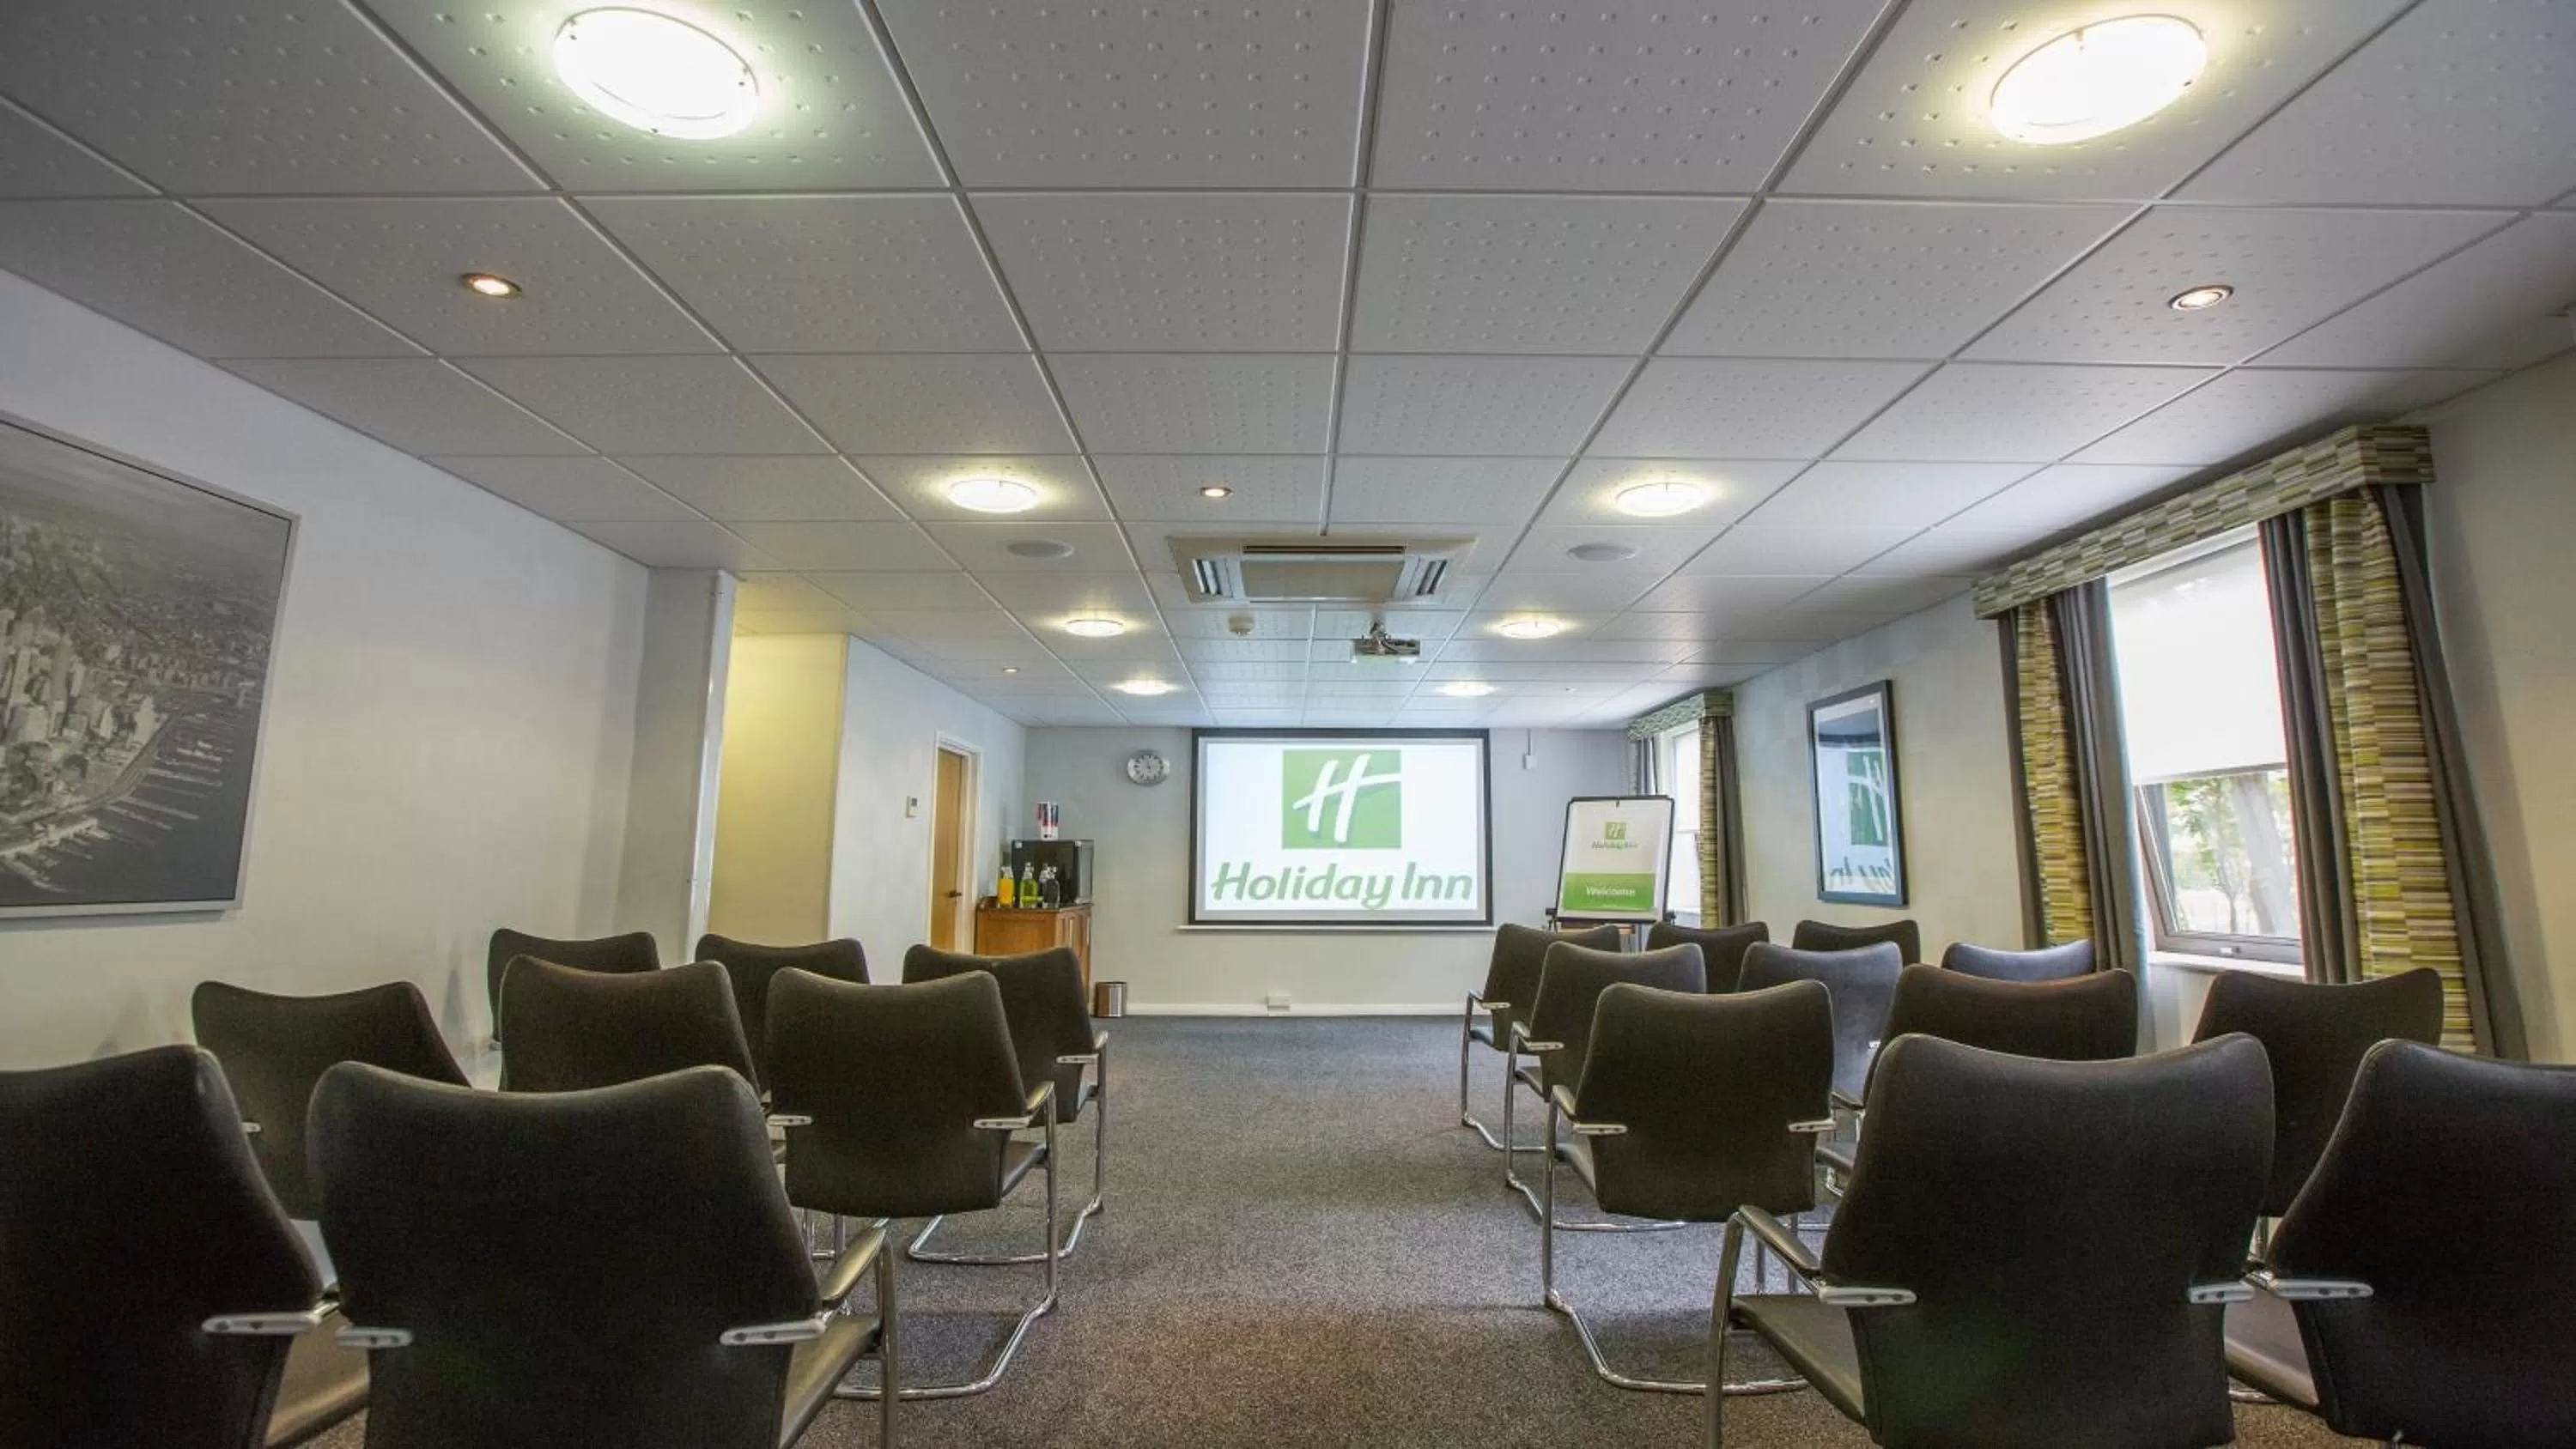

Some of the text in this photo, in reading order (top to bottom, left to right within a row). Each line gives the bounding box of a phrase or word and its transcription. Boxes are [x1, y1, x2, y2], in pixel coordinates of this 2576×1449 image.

[1212, 862, 1473, 910] Holiday Inn
[1586, 885, 1636, 897] Welcome
